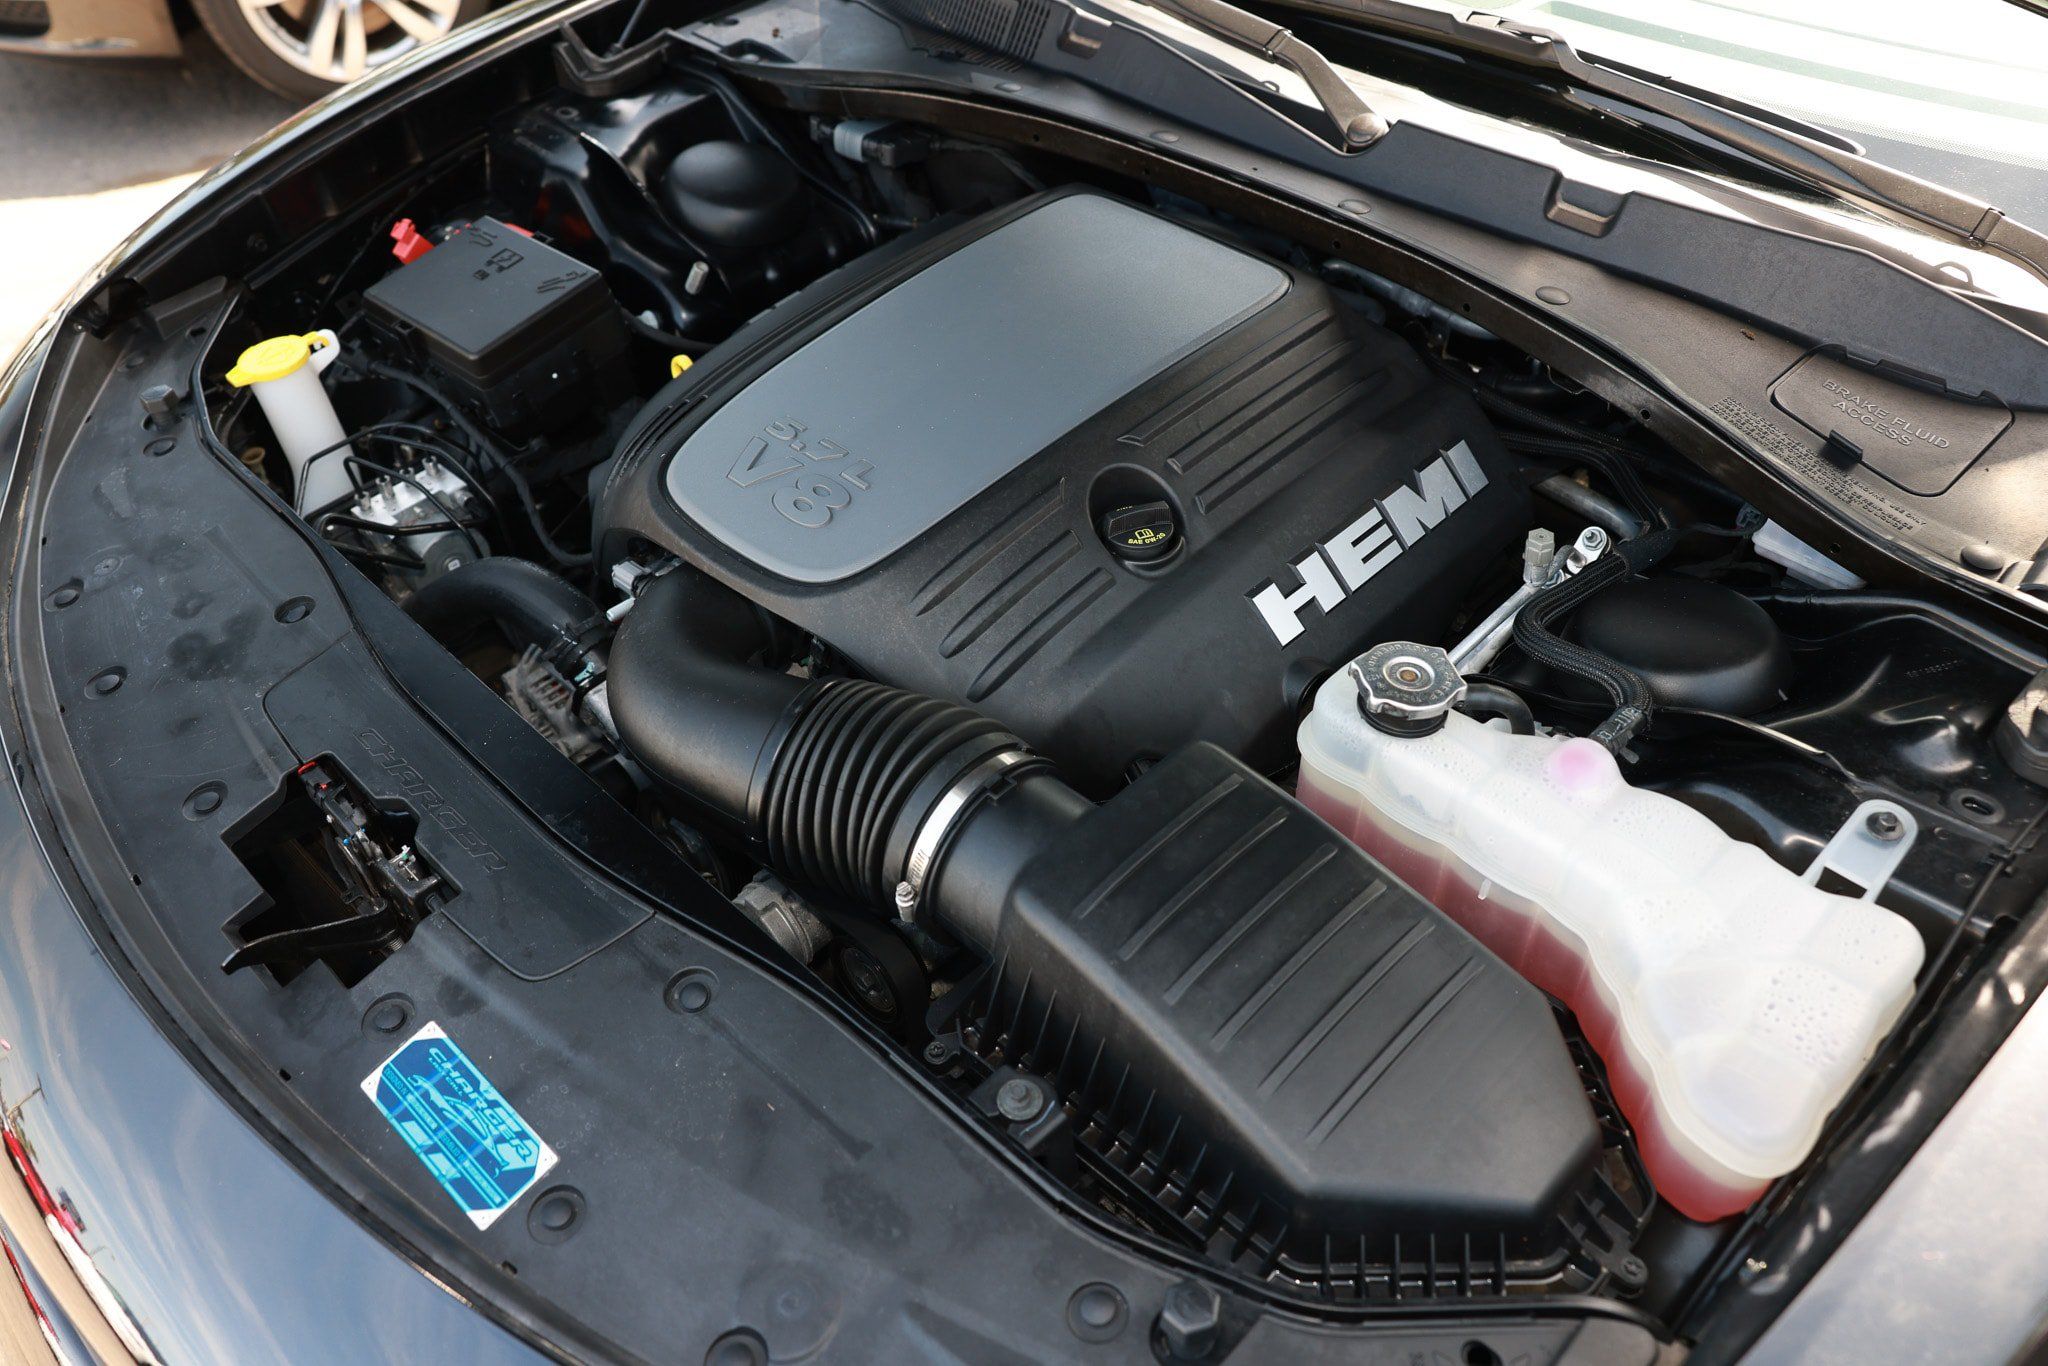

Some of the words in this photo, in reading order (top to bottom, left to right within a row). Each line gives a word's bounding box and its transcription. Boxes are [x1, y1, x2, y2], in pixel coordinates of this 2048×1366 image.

[1822, 378, 1889, 418] BRAKE
[1892, 416, 1949, 449] FLUID
[1833, 400, 1912, 446] ACCESS
[726, 435, 852, 529] V8
[764, 415, 876, 491] 5.7L
[1127, 537, 1143, 545] SAE
[1246, 438, 1490, 650] HEMI
[352, 728, 508, 874] CHARGER
[427, 1055, 447, 1077] LAST
[444, 1075, 464, 1097] CALL
[429, 1047, 533, 1163] CHARGER
